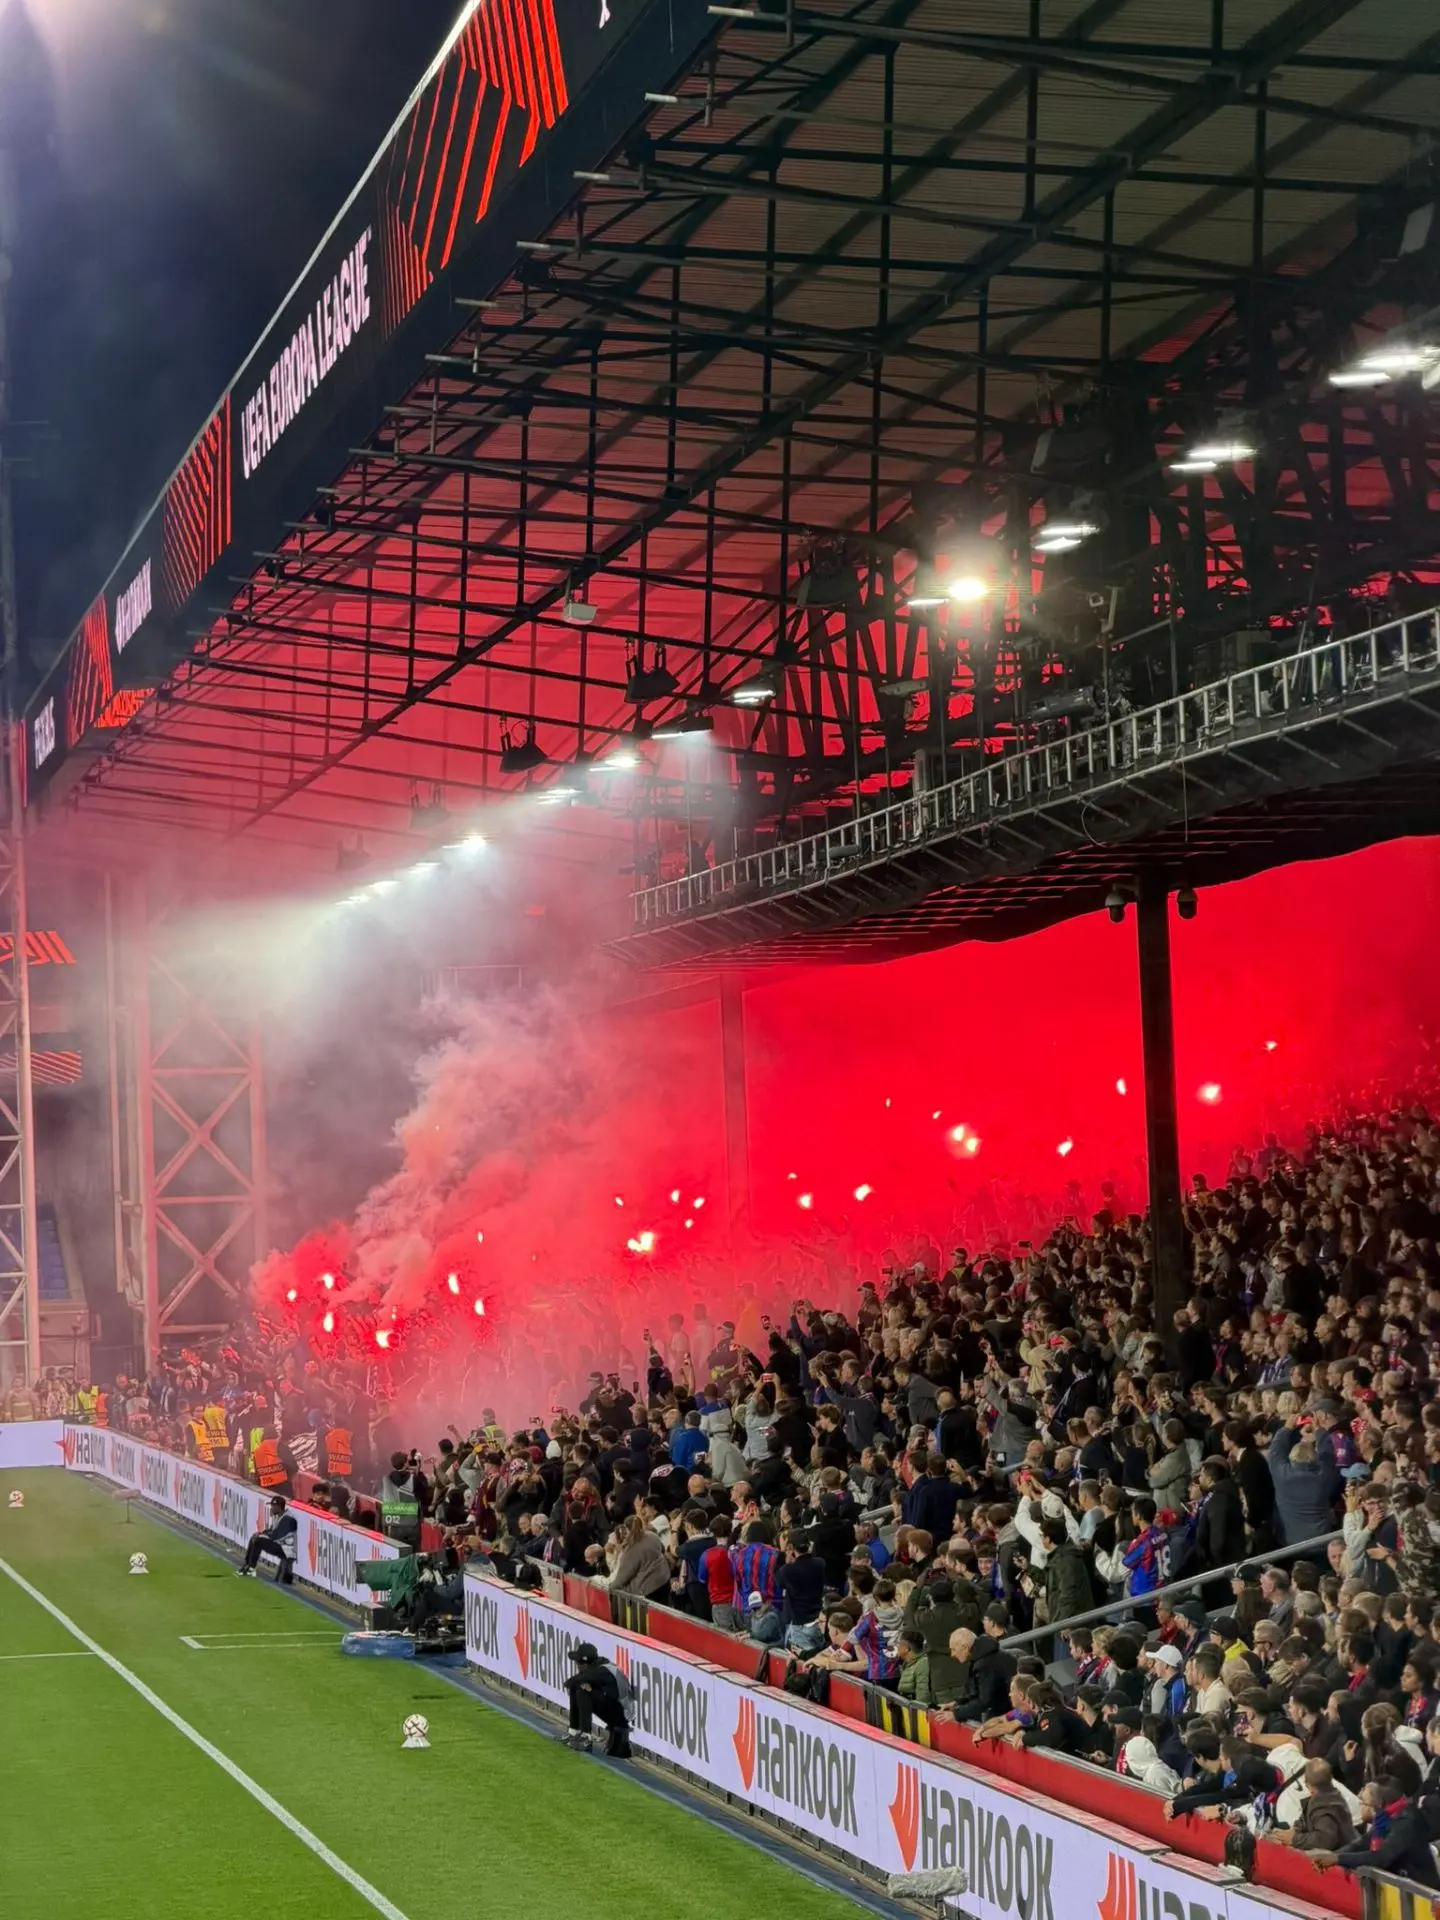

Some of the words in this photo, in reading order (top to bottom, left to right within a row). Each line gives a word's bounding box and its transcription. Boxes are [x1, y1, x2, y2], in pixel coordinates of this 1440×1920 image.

[241, 380, 271, 479] UEFA
[269, 312, 318, 444] EUROPA
[316, 228, 371, 380] LEAGUE
